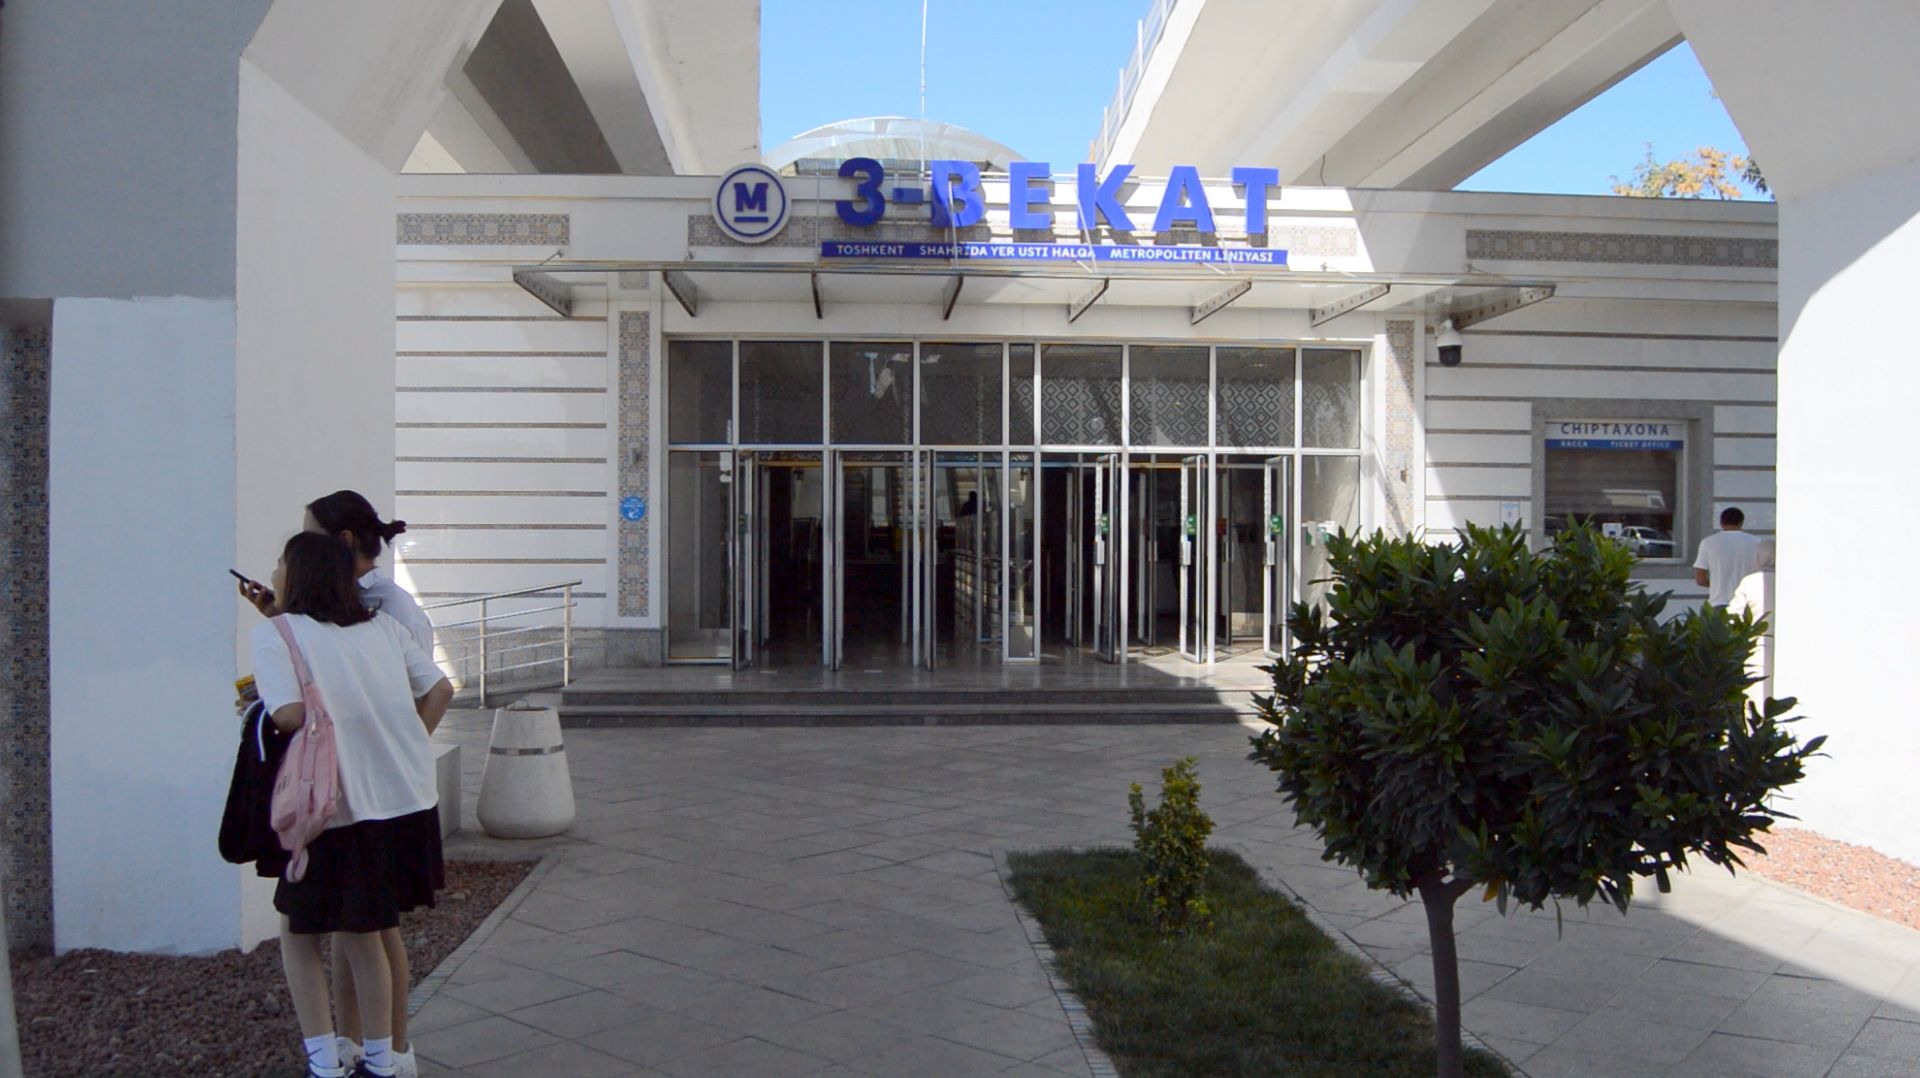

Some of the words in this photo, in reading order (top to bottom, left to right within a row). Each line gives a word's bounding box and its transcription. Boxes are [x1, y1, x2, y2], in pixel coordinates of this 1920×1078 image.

[733, 182, 769, 213] M
[835, 157, 1279, 235] 3-BEKAT
[836, 244, 905, 256] TOSHKENT
[919, 244, 988, 257] SHAHRIDA
[990, 245, 1016, 258] YER
[1018, 246, 1049, 258] USTI
[1051, 246, 1096, 260] HALQA
[1108, 247, 1212, 261] METROPOLITEN
[1215, 249, 1273, 263] LINIYASI
[1560, 422, 1670, 436] CHIPTAXONA
[1610, 441, 1639, 449] TICKET
[1641, 441, 1670, 449] OFFICE
